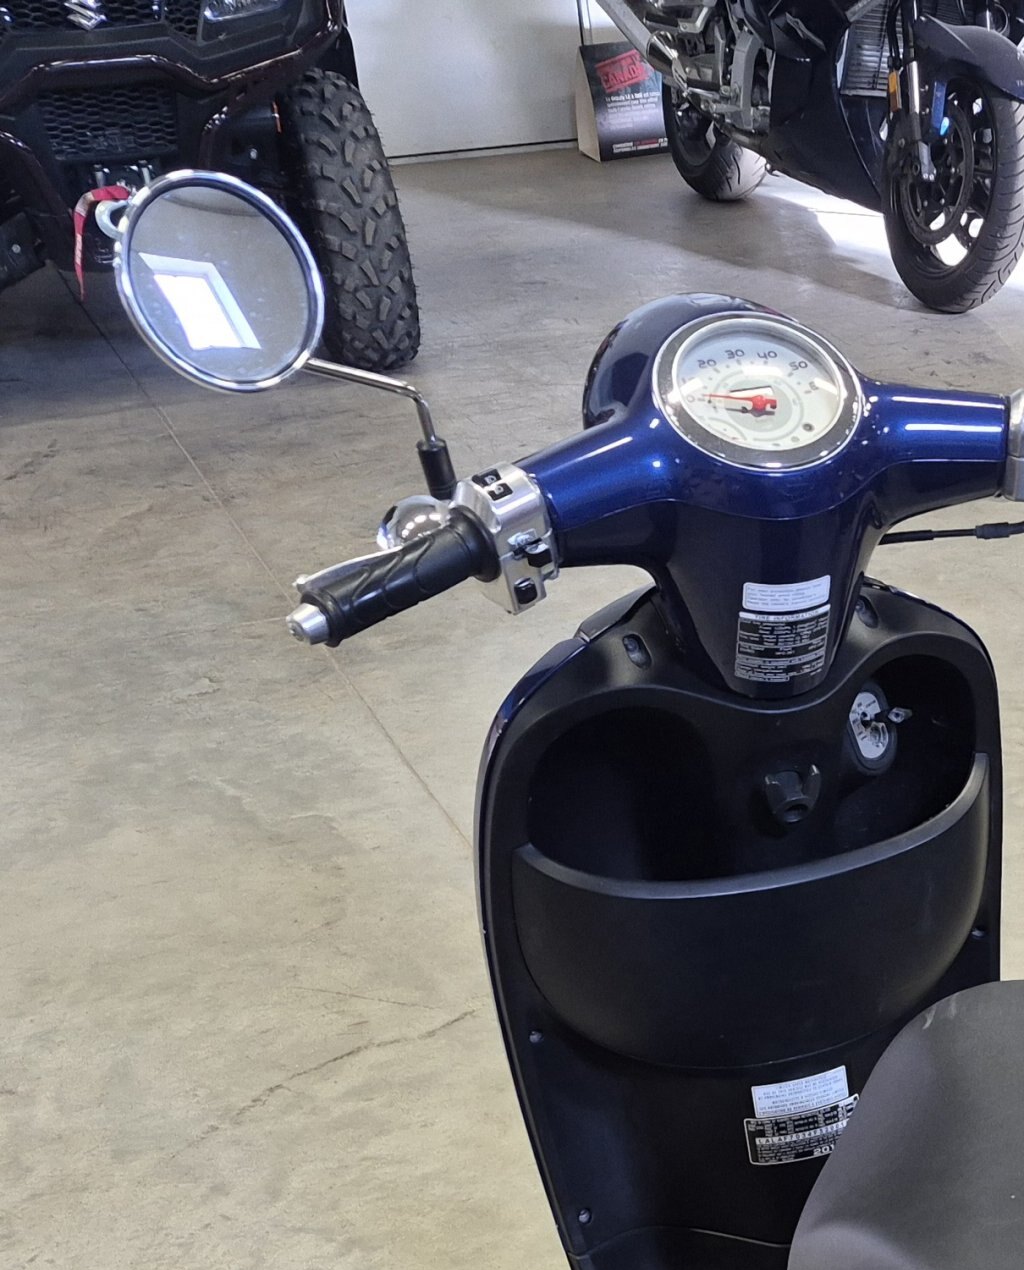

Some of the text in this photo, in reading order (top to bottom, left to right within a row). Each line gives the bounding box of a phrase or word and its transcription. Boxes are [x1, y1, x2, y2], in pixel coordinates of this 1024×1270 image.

[725, 349, 745, 359] 30
[757, 350, 777, 360] 40
[697, 358, 717, 369] 20
[789, 360, 808, 371] 50
